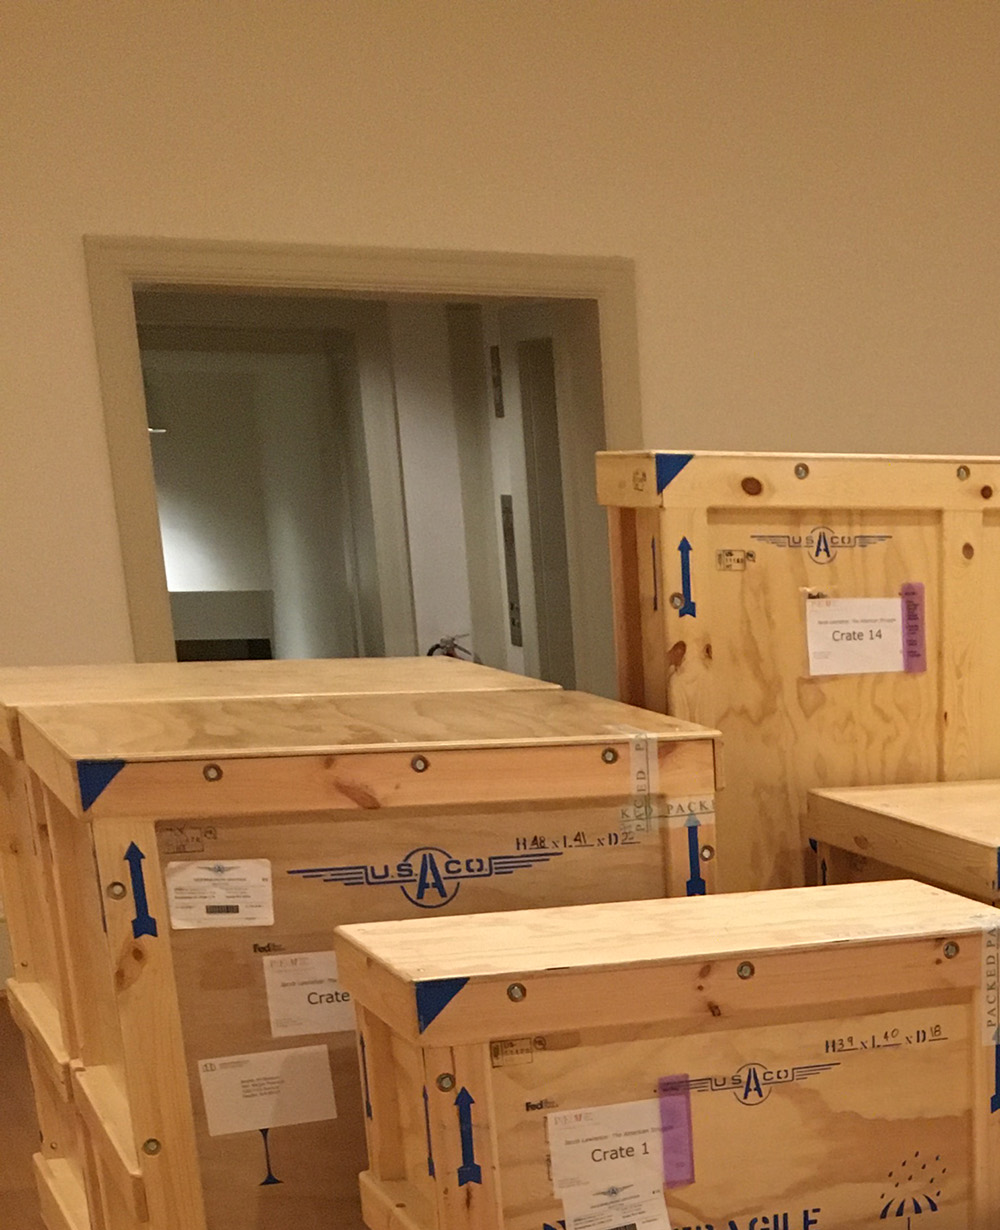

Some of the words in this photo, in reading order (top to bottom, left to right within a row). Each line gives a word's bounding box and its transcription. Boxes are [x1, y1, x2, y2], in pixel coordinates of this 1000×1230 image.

[832, 630, 864, 642] Crate
[868, 629, 882, 641] 14
[307, 990, 350, 1005] Crate
[986, 955, 997, 1028] PACKED
[591, 1145, 635, 1163] Crate
[641, 1142, 650, 1156] 1
